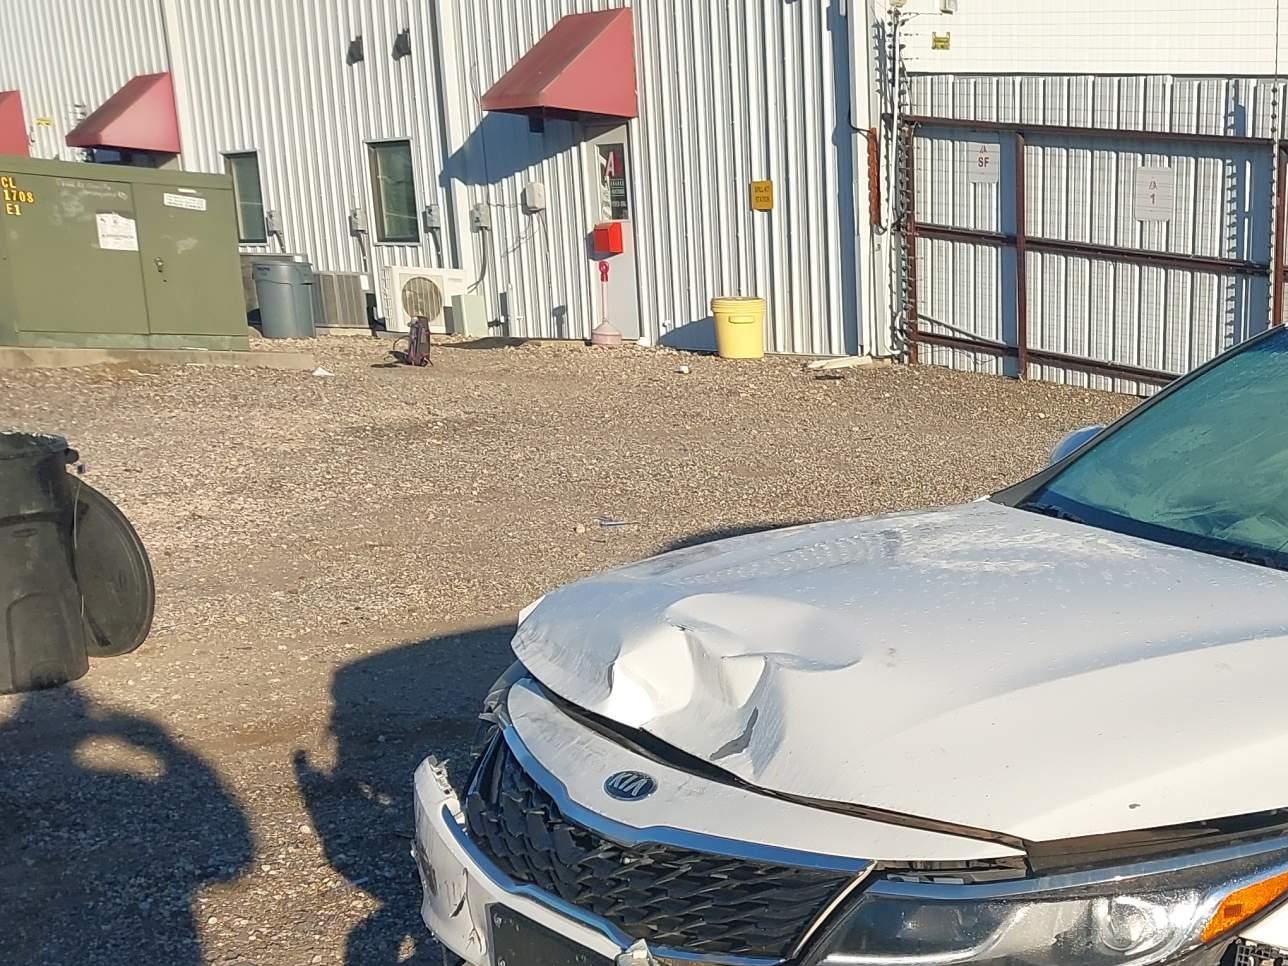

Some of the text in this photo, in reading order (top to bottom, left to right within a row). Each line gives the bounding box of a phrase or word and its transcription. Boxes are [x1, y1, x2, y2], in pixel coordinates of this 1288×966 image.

[978, 157, 990, 168] SF
[1, 176, 17, 189] CL
[1150, 193, 1155, 205] 1
[6, 203, 22, 216] E1
[607, 772, 648, 797] KIA
